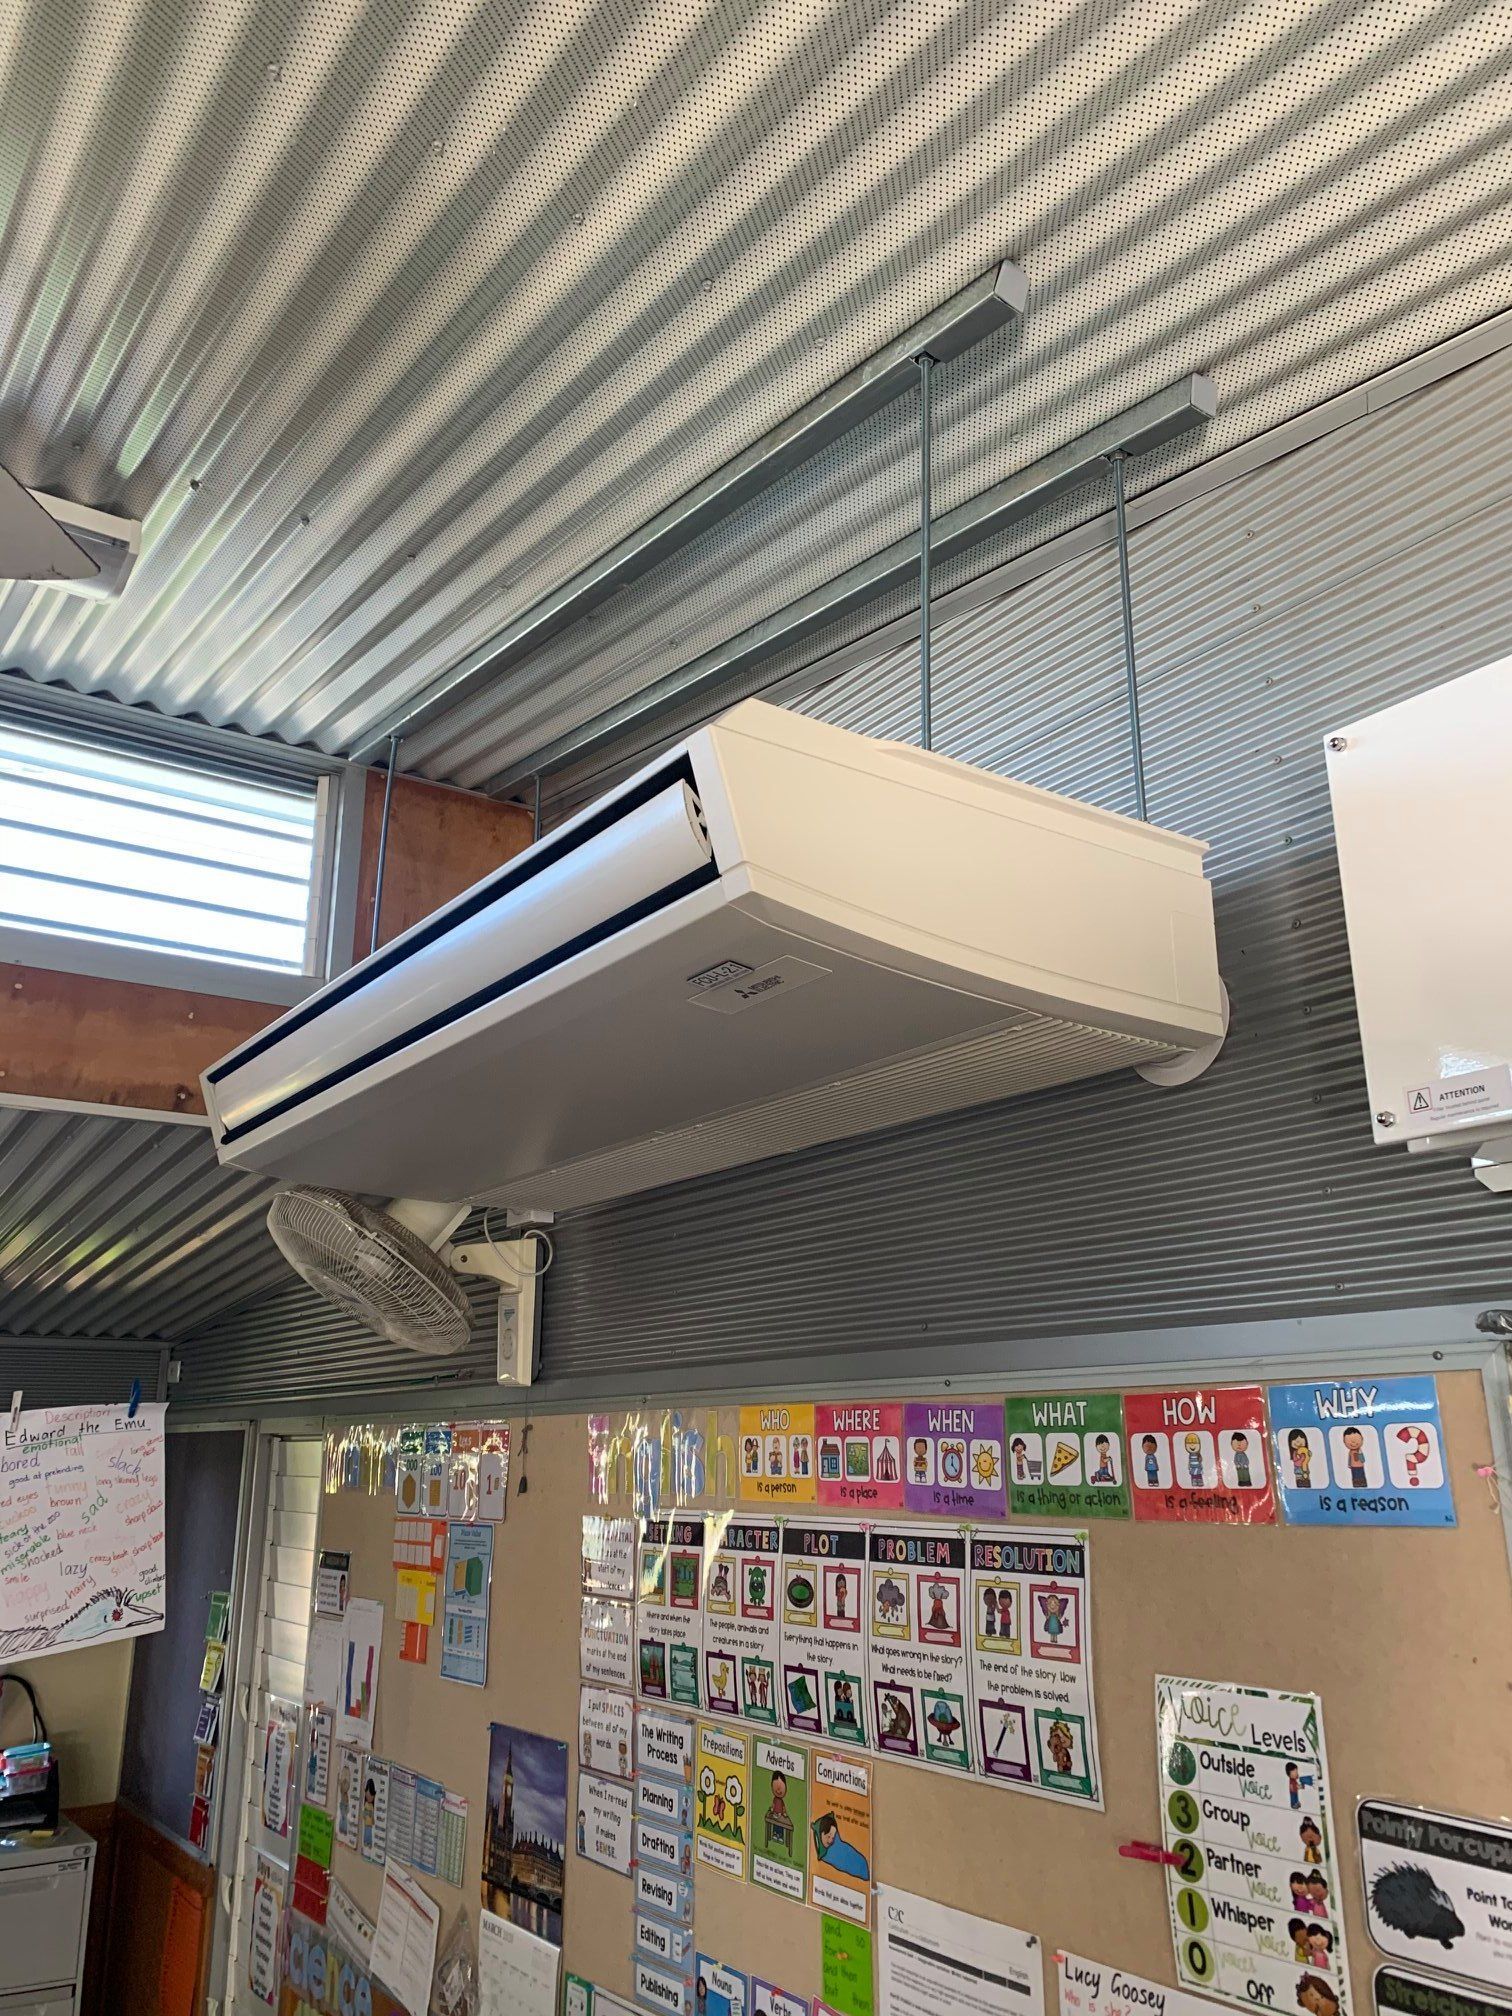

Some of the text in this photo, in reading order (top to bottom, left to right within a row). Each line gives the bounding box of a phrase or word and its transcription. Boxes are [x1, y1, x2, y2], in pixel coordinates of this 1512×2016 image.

[1439, 1085, 1485, 1101] ATTENTION
[1032, 1400, 1087, 1428] WHAT
[1163, 1396, 1217, 1426] HOW
[1314, 1386, 1378, 1420] WHY
[45, 1408, 111, 1425] Description
[760, 1408, 790, 1432] WHO
[832, 1408, 881, 1432] WHERE
[927, 1408, 975, 1433] WHEN
[5, 1418, 146, 1447] Edward the Emu
[22, 1433, 83, 1454] emotional
[0, 1452, 40, 1473] bored
[9, 1475, 30, 1489] good
[33, 1472, 41, 1480] at
[486, 1474, 492, 1495] 1
[757, 1482, 797, 1498] is a person
[49, 1496, 82, 1508] brown
[840, 1485, 878, 1503] is a place
[933, 1489, 975, 1507] is a time
[1016, 1488, 1122, 1510] is a thing or action
[1164, 1491, 1239, 1515] is a feeling
[1318, 1494, 1410, 1513] is a reason
[81, 1489, 108, 1524] sad
[0, 1524, 29, 1544] teary
[56, 1529, 75, 1540] blue
[0, 1534, 51, 1576] miserable
[20, 1543, 64, 1570] shocked
[649, 1522, 1081, 1574] SETING ARACTER PLOT PROBLEM RESOLUTION
[5, 1573, 31, 1585] smile
[60, 1561, 88, 1579] lazy
[139, 1564, 158, 1582] good
[65, 1575, 97, 1599] hairy
[135, 1583, 163, 1603] upset
[24, 1598, 70, 1623] surprised
[584, 1627, 629, 1646] PUNCTUATION
[709, 1618, 769, 1634] The people, animals and
[712, 1636, 765, 1652] creatures in a story
[784, 1631, 859, 1651] Everything that happens in
[616, 1653, 627, 1662] end
[806, 1651, 834, 1667] the story
[871, 1643, 963, 1668] What goes wrong in the story?
[881, 1662, 953, 1683] What needs to be fixed?
[980, 1659, 1077, 1684] The end of the How
[987, 1680, 1042, 1698] the problem is
[602, 1701, 625, 1718] SPACES
[582, 1716, 604, 1729] between
[619, 1727, 628, 1738] my
[641, 1723, 684, 1750] The Writing
[1250, 1722, 1307, 1754] Levels
[647, 1743, 678, 1765] Process
[703, 1733, 744, 1760] Prepositions
[765, 1750, 795, 1773] Adverbs
[1199, 1750, 1256, 1778] Outside
[817, 1762, 867, 1791] Conjunctions
[588, 1784, 628, 1808] When re-read
[642, 1787, 674, 1812] Planning
[593, 1806, 621, 1826] my writing
[1176, 1794, 1251, 1832] 3 Group
[600, 1828, 616, 1842] makes
[1361, 1810, 1424, 1849] Pointy
[641, 1832, 675, 1859] Drafting
[1178, 1841, 1263, 1880] 2 Partner
[641, 1878, 673, 1906] Revising
[1466, 1887, 1498, 1908] Point
[1186, 1892, 1275, 1933] 1 Whisper
[640, 1924, 666, 1952] Editing
[1188, 1940, 1207, 1976] 0
[641, 1973, 679, 2008] Publishing
[712, 1970, 733, 1995] Nouns
[1064, 1956, 1102, 1999] Lucy
[1110, 1972, 1166, 2016] Goosey
[1246, 1979, 1276, 2006] Off
